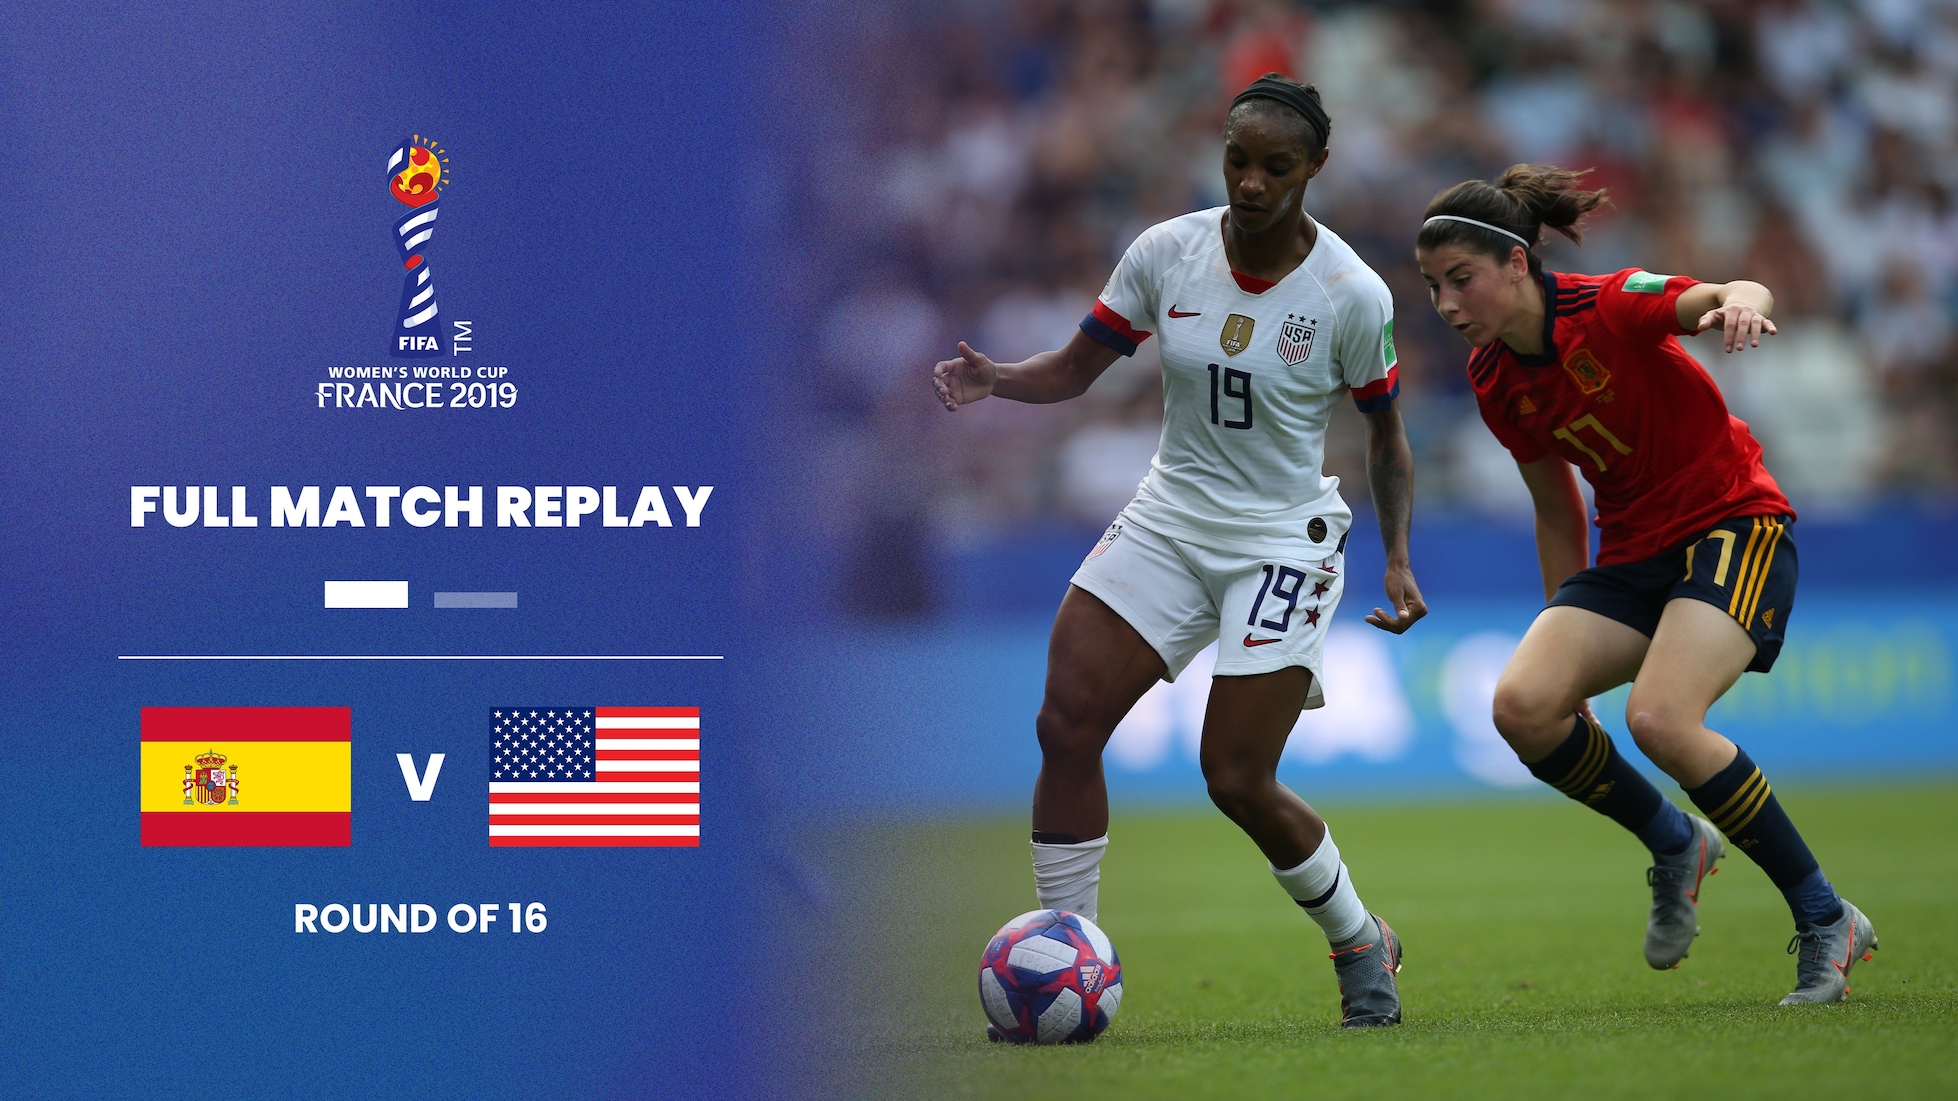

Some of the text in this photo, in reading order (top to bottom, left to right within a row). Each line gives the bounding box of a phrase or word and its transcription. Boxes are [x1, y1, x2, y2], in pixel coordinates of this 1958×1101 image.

[1285, 325, 1312, 343] USA
[1207, 363, 1253, 430] 19
[1552, 413, 1634, 472] 17
[1247, 564, 1307, 633] 19
[1085, 963, 1102, 994] adidas
